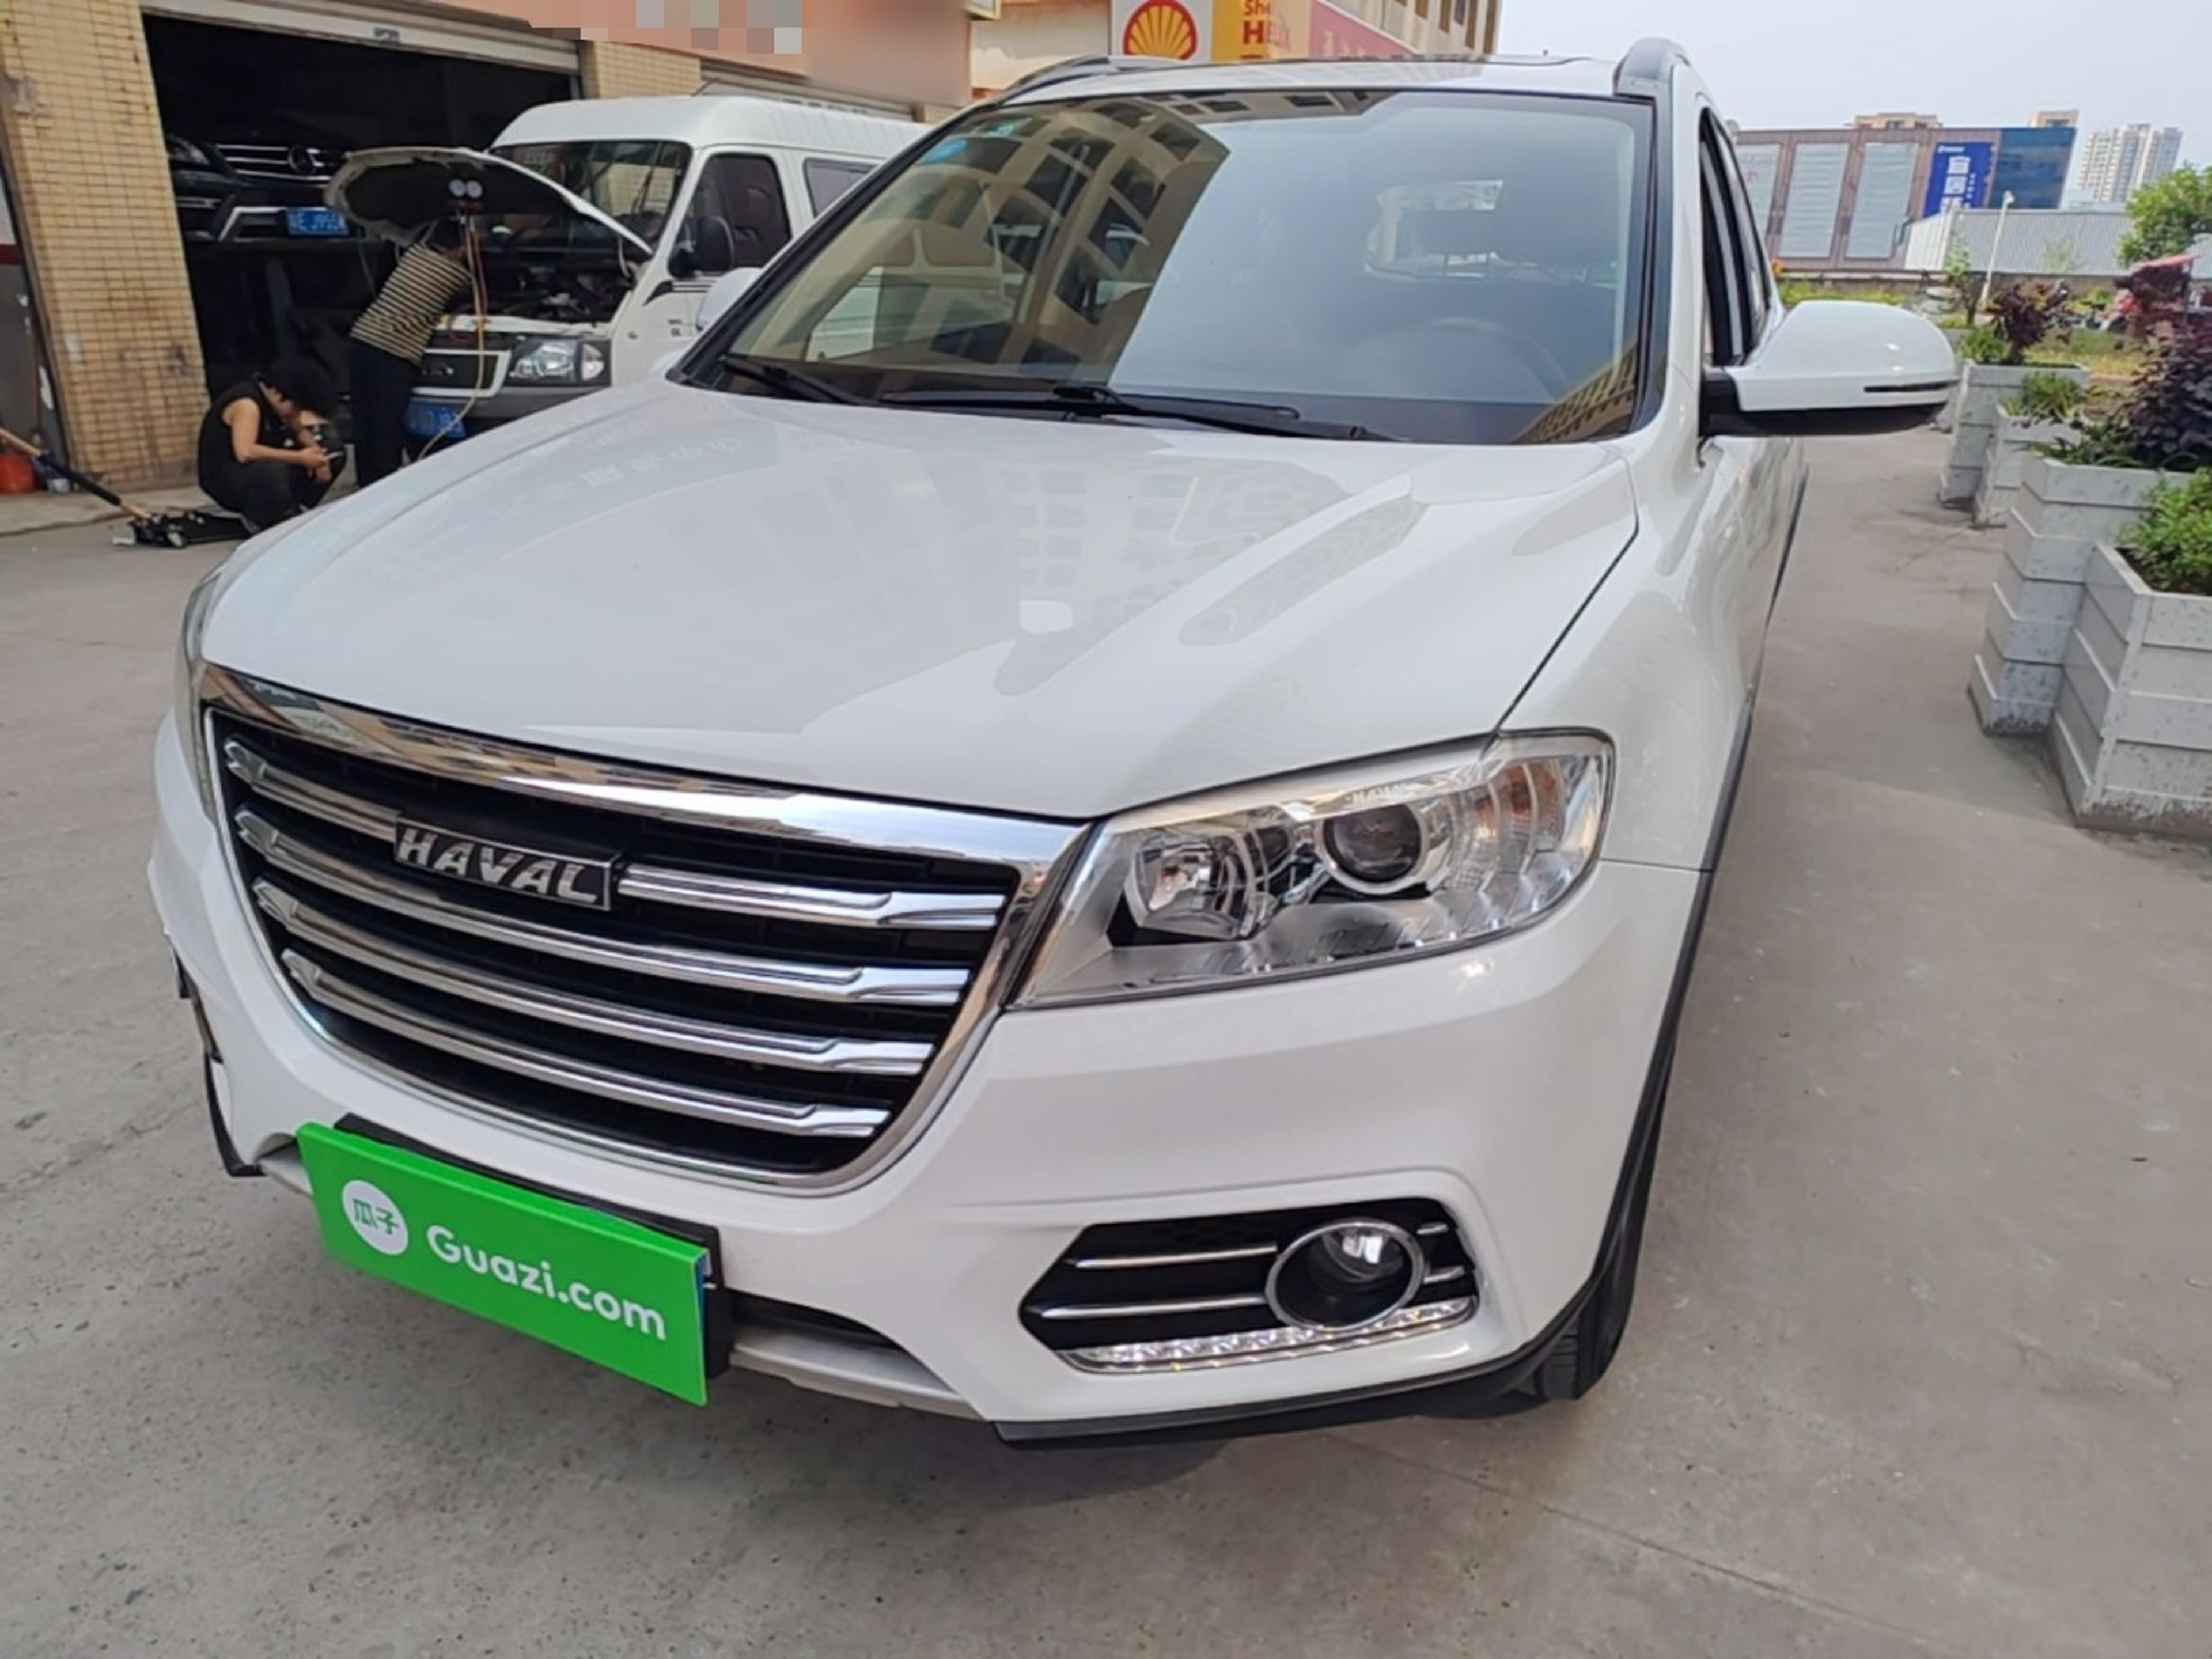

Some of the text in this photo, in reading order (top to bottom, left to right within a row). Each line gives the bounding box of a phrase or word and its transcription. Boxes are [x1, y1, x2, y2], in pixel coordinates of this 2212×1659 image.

[397, 828, 598, 903] HAVAL
[352, 1198, 400, 1236] 瓜子
[426, 1225, 666, 1340] Guazi.com
